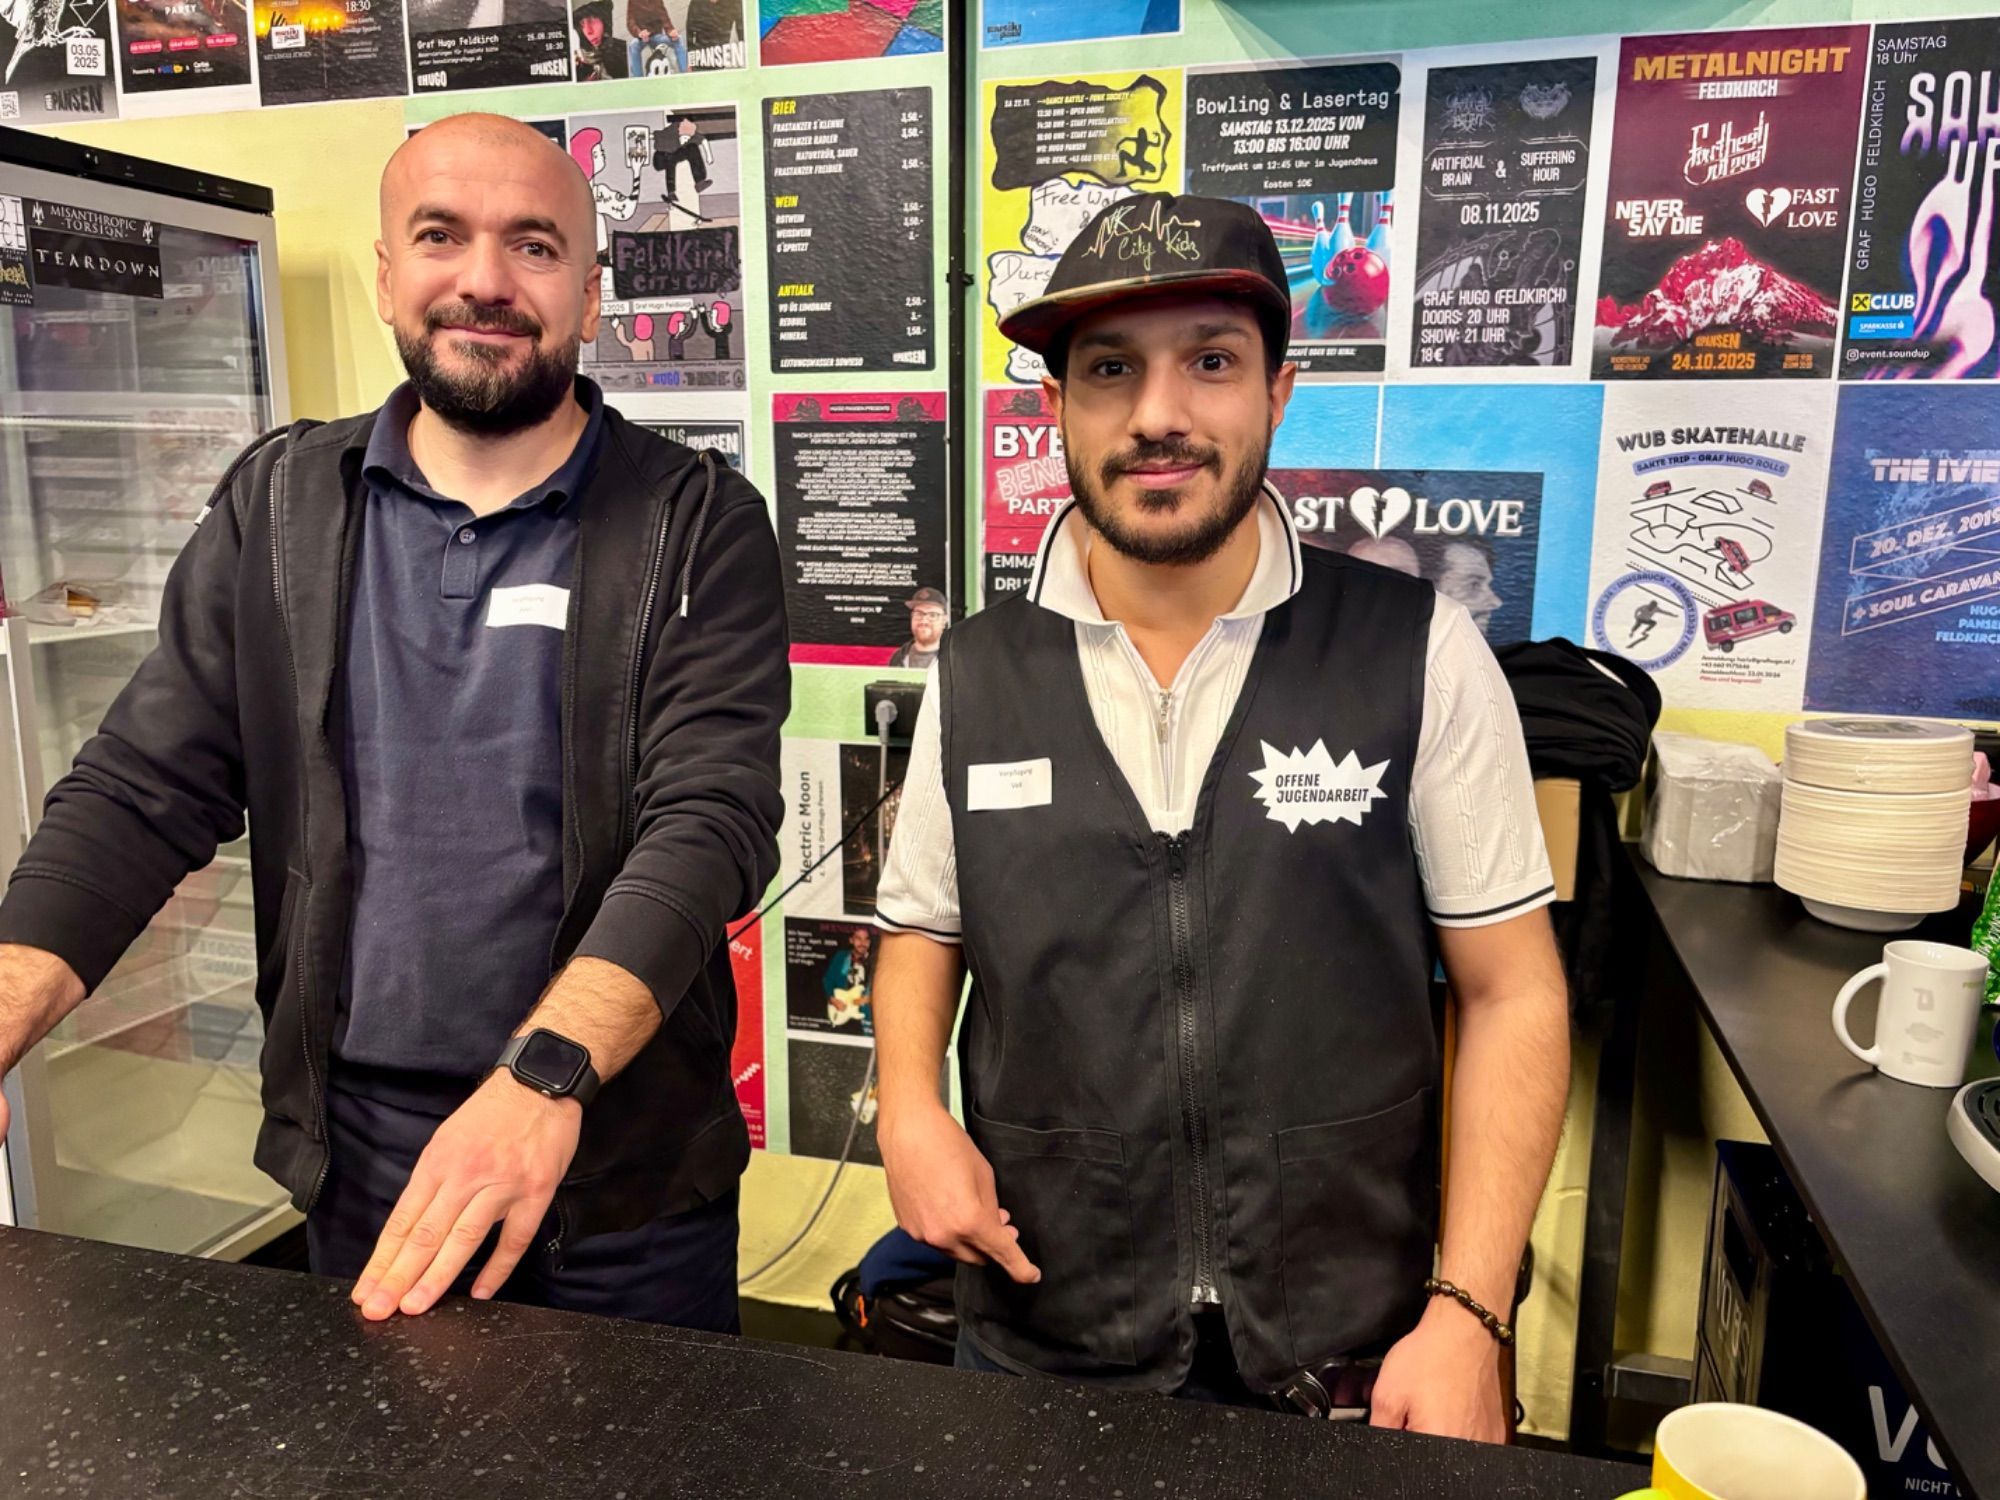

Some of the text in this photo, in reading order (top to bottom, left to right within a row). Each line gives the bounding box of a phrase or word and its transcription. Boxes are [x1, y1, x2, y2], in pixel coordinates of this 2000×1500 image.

[164, 4, 197, 15] PARTY
[345, 0, 371, 12] 18:30
[71, 45, 101, 56] 03.05.
[417, 35, 500, 49] Graf Hugo Feldkirch
[1877, 35, 1947, 51] SAMSTAG
[74, 57, 99, 68] 2025
[691, 41, 744, 67] PANSEN
[1876, 51, 1918, 64] 18 Uhr
[1633, 47, 1851, 81] METALNIGHT
[1699, 79, 1777, 99] FELDKIRCH
[772, 100, 797, 115] BIER
[1197, 89, 1389, 115] Bowling & Lasertag
[1220, 115, 1366, 137] SAMSTAG 13.12.2025 VON
[1233, 134, 1350, 155] 13:00 BIS 16:00 UHR
[1202, 161, 1248, 173] Treffpunkt
[1267, 160, 1291, 170] 12:45
[1295, 159, 1311, 169] Uhr
[1329, 156, 1378, 169] Jugendhaus
[1431, 155, 1486, 171] ARTIFICIAL
[1520, 150, 1576, 166] SUFFERING
[1495, 160, 1507, 178] &
[1532, 167, 1560, 182] HOUR
[1856, 79, 1887, 270] GRAF HUGO FELDKIRCH
[1263, 178, 1293, 189] Kosten
[1442, 172, 1472, 187] BRAIN
[1036, 181, 1081, 207] Free
[1791, 188, 1839, 206] FAST
[50, 205, 137, 231] MISANTHROPIC
[1460, 202, 1541, 225] 08.11.2025
[1615, 199, 1684, 220] NEVER
[1628, 215, 1704, 236] SAY DIE
[1788, 210, 1838, 228] LOVE
[1119, 234, 1156, 271] City
[36, 249, 159, 278] TEARDOWN
[1423, 287, 1567, 306] GRAF HUGO (FELDKIRCH)
[1871, 295, 1915, 310] CLUB
[1422, 309, 1510, 325] DOORS: 20 UHR
[1421, 328, 1506, 344] SHOW: 21 UHR
[1421, 347, 1444, 363] 18€
[1672, 353, 1755, 370] 24.10.2025
[1859, 349, 1930, 359] event.soundup
[689, 433, 738, 453] PANSEN
[1616, 427, 1807, 453] WUB SKATEHALLE
[1698, 453, 1725, 463] GRAF
[1726, 454, 1754, 465] HUGO
[1756, 460, 1787, 474] ROLLS
[1871, 459, 1931, 482] THE
[1008, 498, 1061, 515] PART
[1294, 497, 1525, 537] ST LOVE
[1906, 522, 1953, 547] DEZ.
[1869, 594, 1917, 618] SOUL
[1970, 605, 2000, 616] HUG
[1958, 618, 2000, 630] PANSE
[1276, 774, 1320, 787] OFFENE
[1276, 788, 1369, 803] JUGENDARBEIT
[798, 771, 812, 883] Electric Moon
[1905, 1477, 1952, 1495] NICHT
